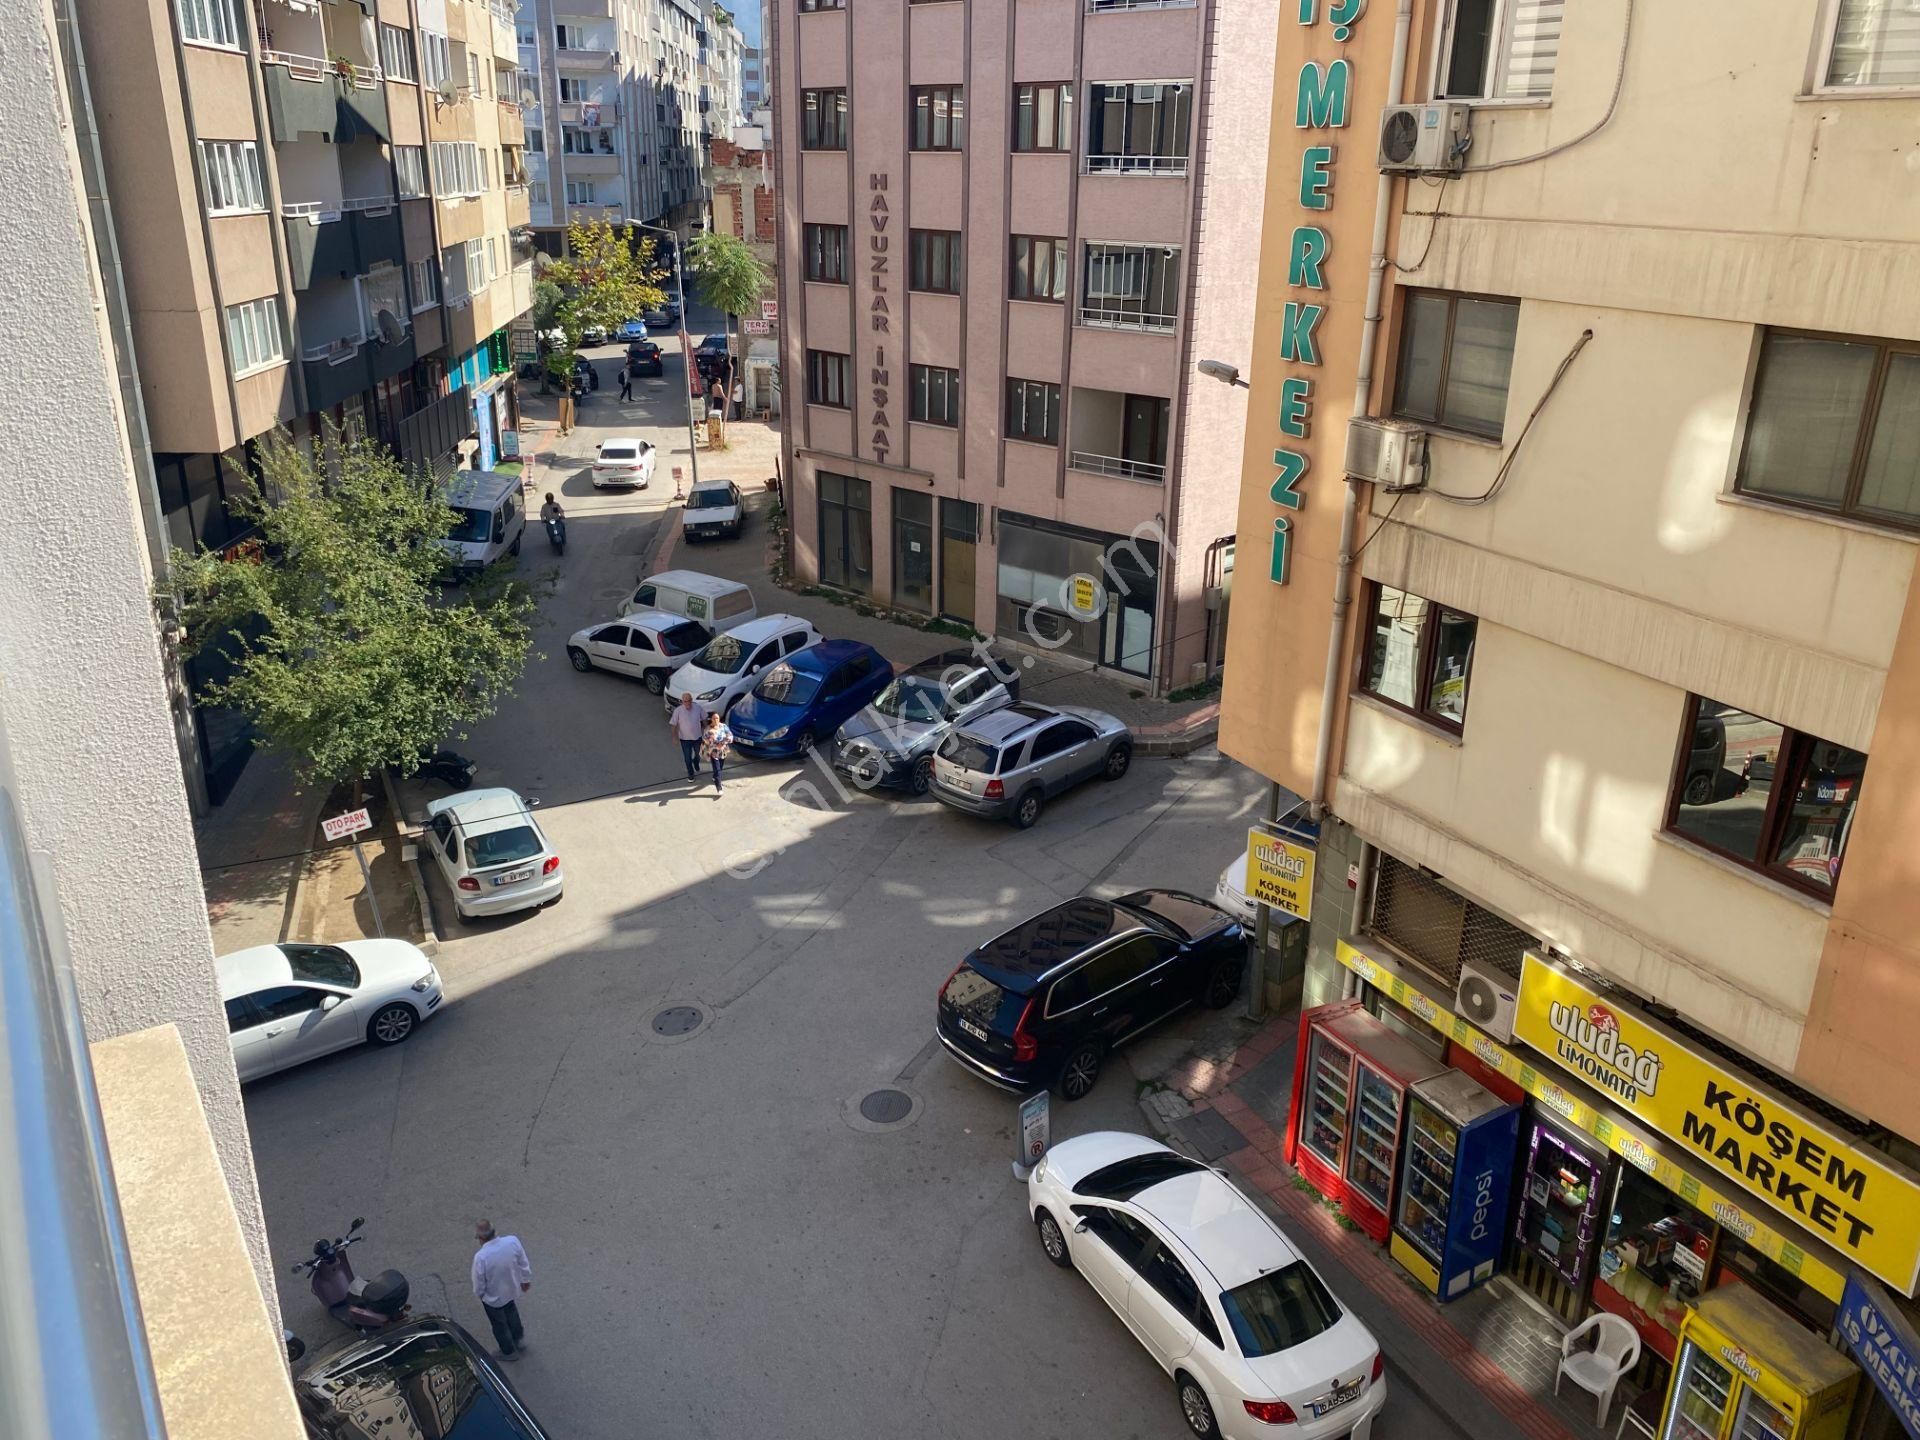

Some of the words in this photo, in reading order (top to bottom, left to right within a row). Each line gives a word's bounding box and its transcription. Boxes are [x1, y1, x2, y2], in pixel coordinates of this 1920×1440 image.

[869, 173, 890, 335] HAVUZLAR
[1270, 60, 1351, 585] MERKEZİ
[871, 345, 890, 463] İNŞAAT
[326, 819, 343, 831] OTO
[343, 812, 366, 825] PARK
[1255, 845, 1305, 878] uludağ
[1255, 889, 1300, 913] MARKET
[1260, 879, 1297, 900] KÖŞEM
[1549, 1001, 1660, 1097] uludağ
[1682, 1111, 1874, 1249] MARKET
[1704, 1081, 1867, 1202] KÖŞEM
[1471, 1169, 1493, 1241] pepsi
